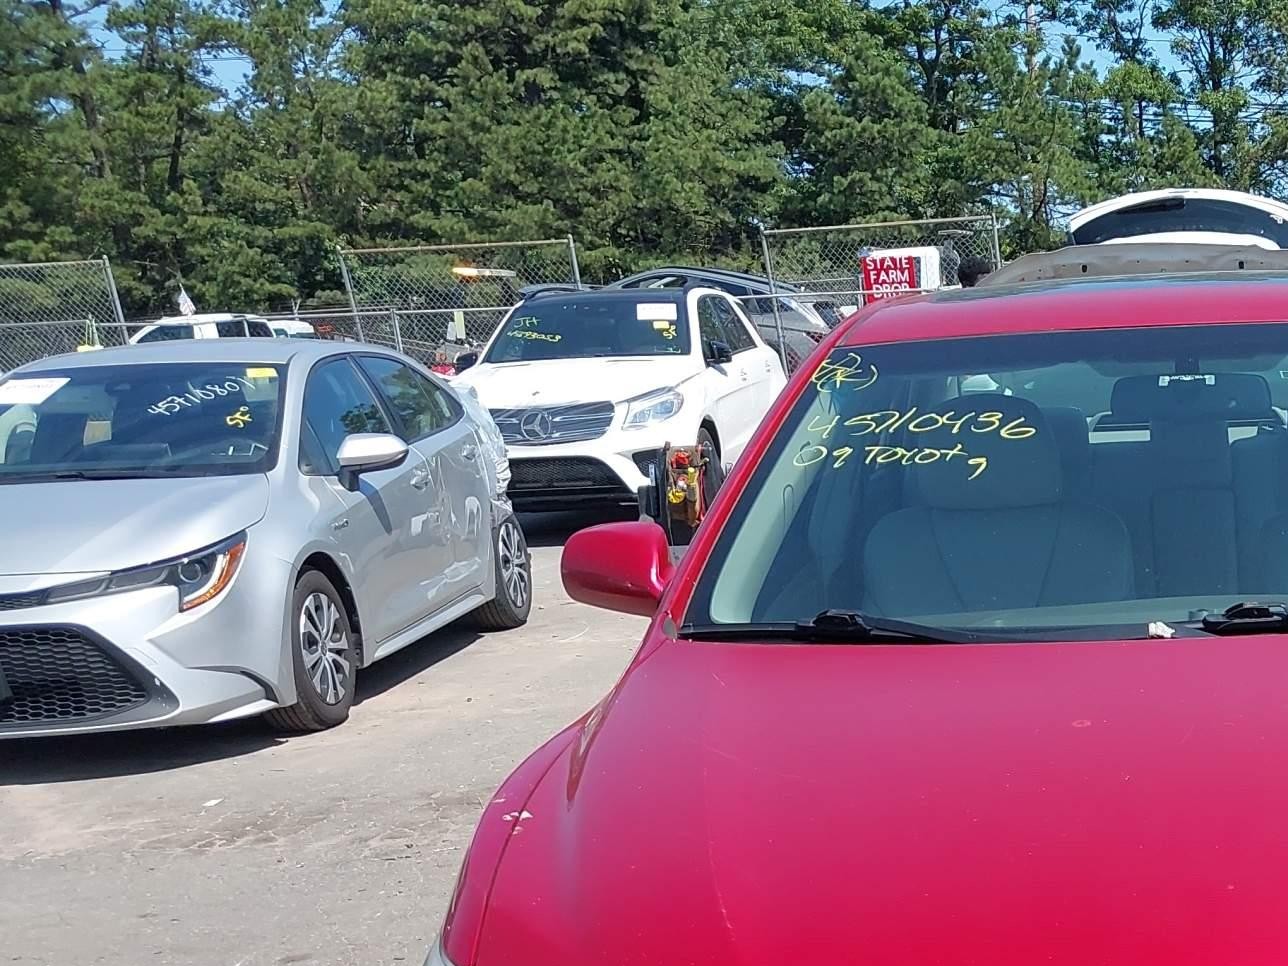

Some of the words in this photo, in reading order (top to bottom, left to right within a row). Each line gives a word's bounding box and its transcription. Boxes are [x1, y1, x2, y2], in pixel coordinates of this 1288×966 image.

[865, 256, 910, 270] STATE
[869, 269, 910, 283] FARM
[807, 407, 1037, 440] 45710436
